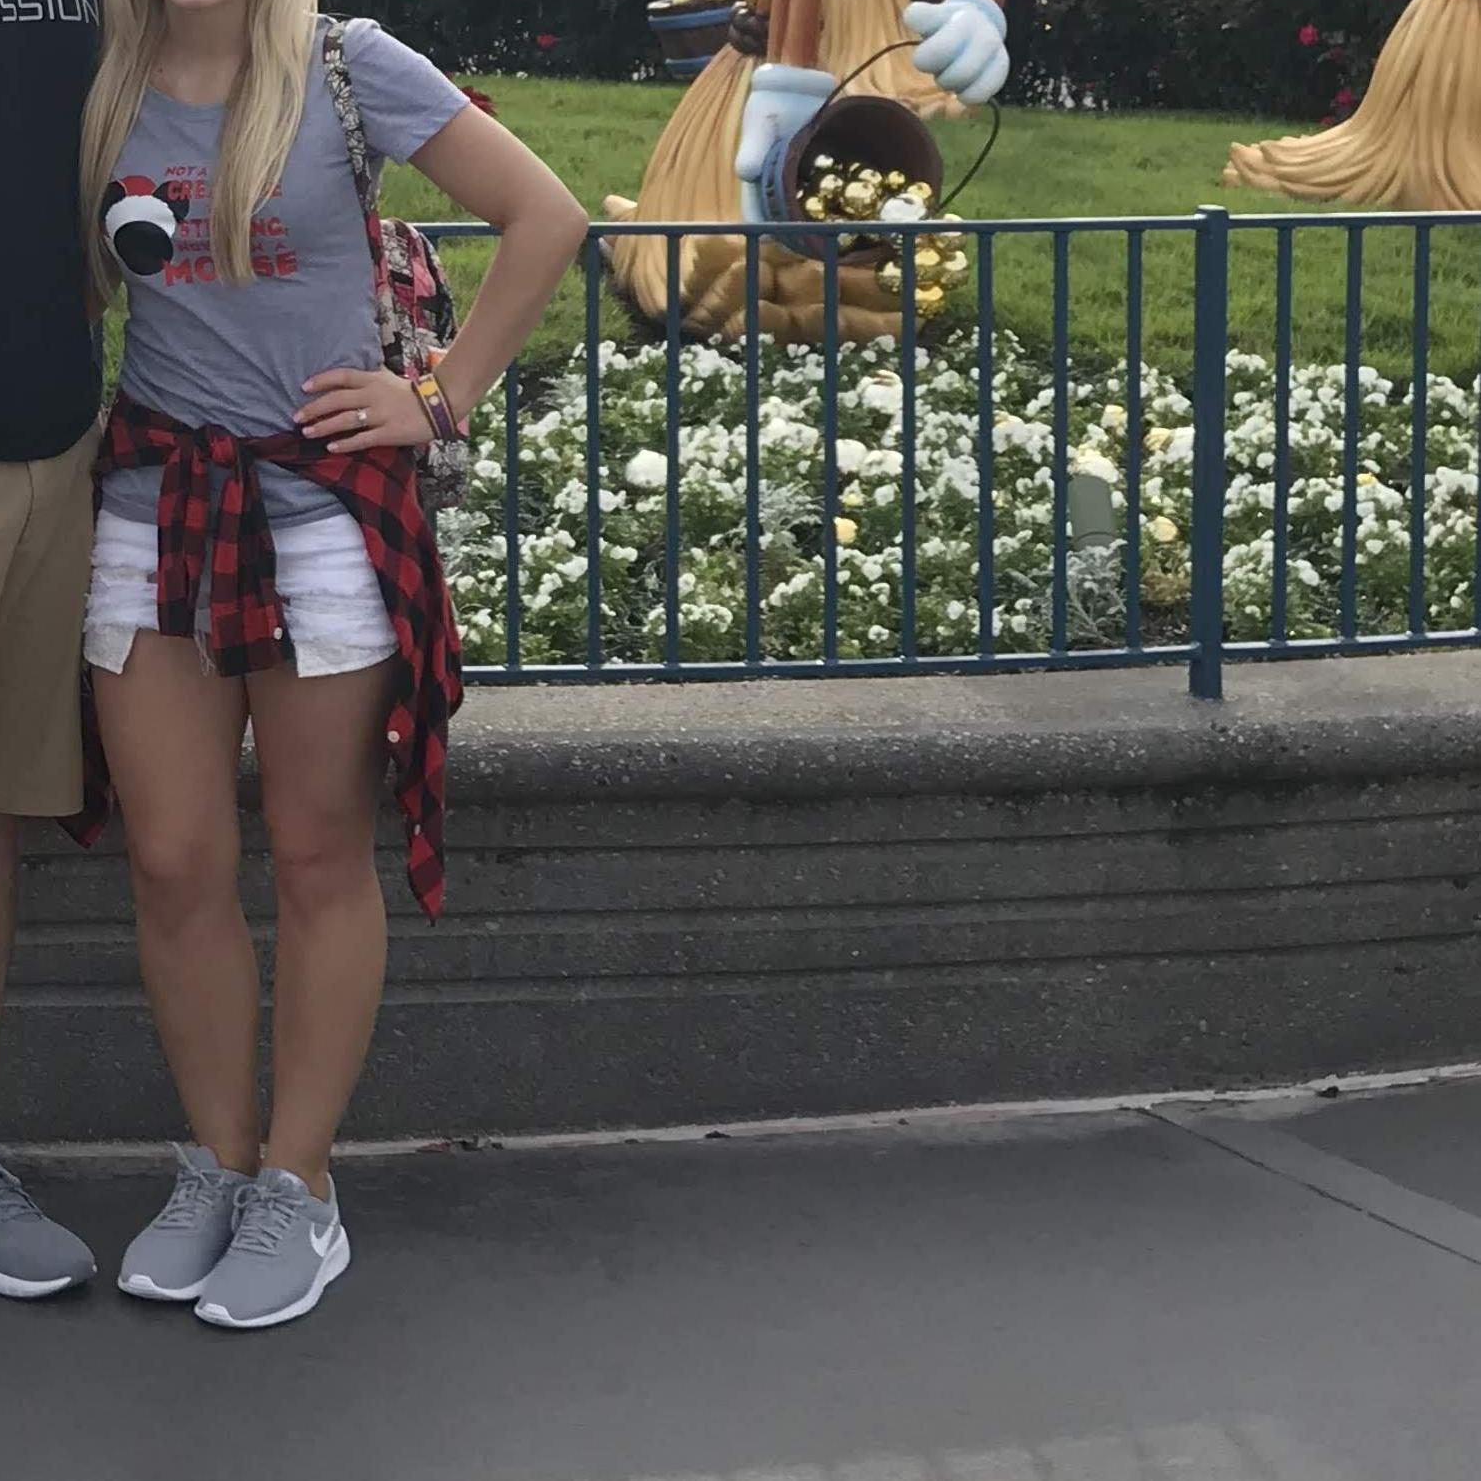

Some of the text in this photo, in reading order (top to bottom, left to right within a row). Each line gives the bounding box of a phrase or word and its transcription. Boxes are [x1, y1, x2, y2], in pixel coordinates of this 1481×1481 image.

[165, 166, 208, 177] NOT A
[163, 252, 298, 287] MOSE
